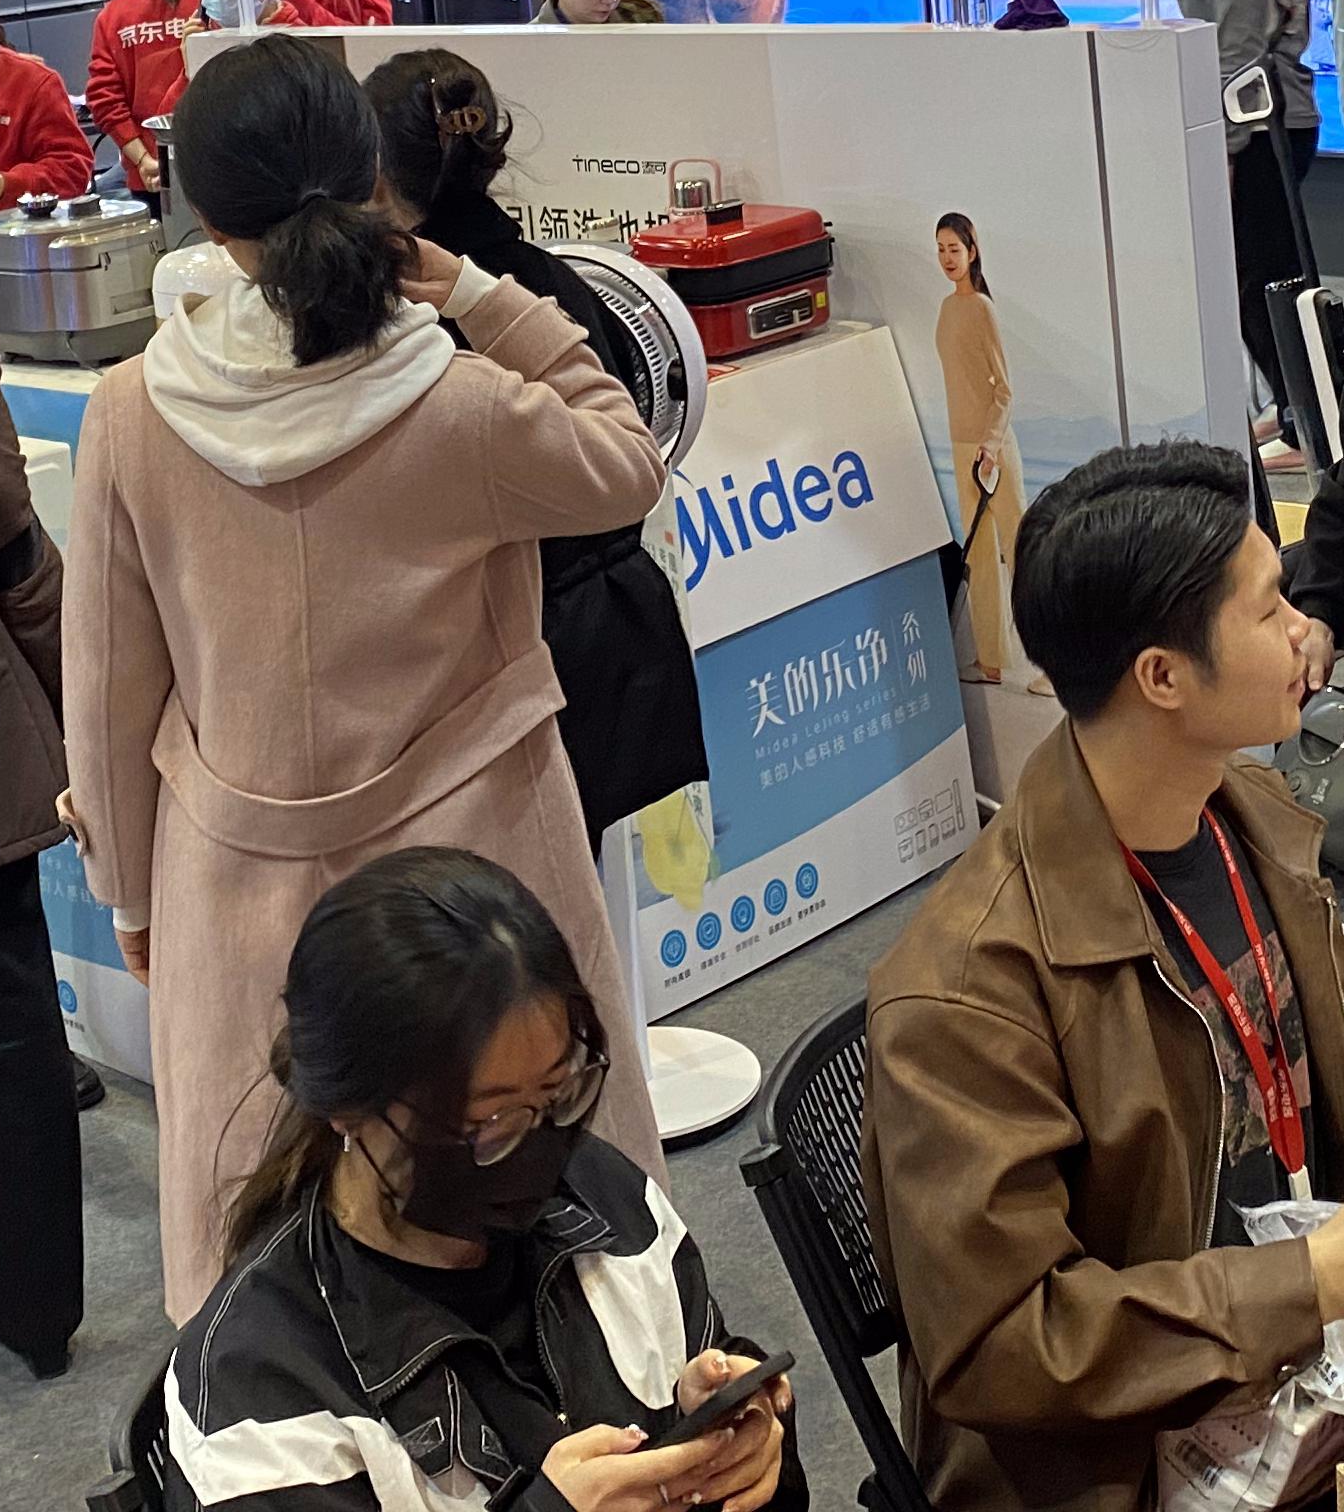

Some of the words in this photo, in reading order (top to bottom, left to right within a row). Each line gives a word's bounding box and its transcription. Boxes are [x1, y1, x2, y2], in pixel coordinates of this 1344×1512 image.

[665, 448, 875, 593] Midea
[743, 626, 889, 739] 美的乐净
[901, 609, 928, 688] 系列
